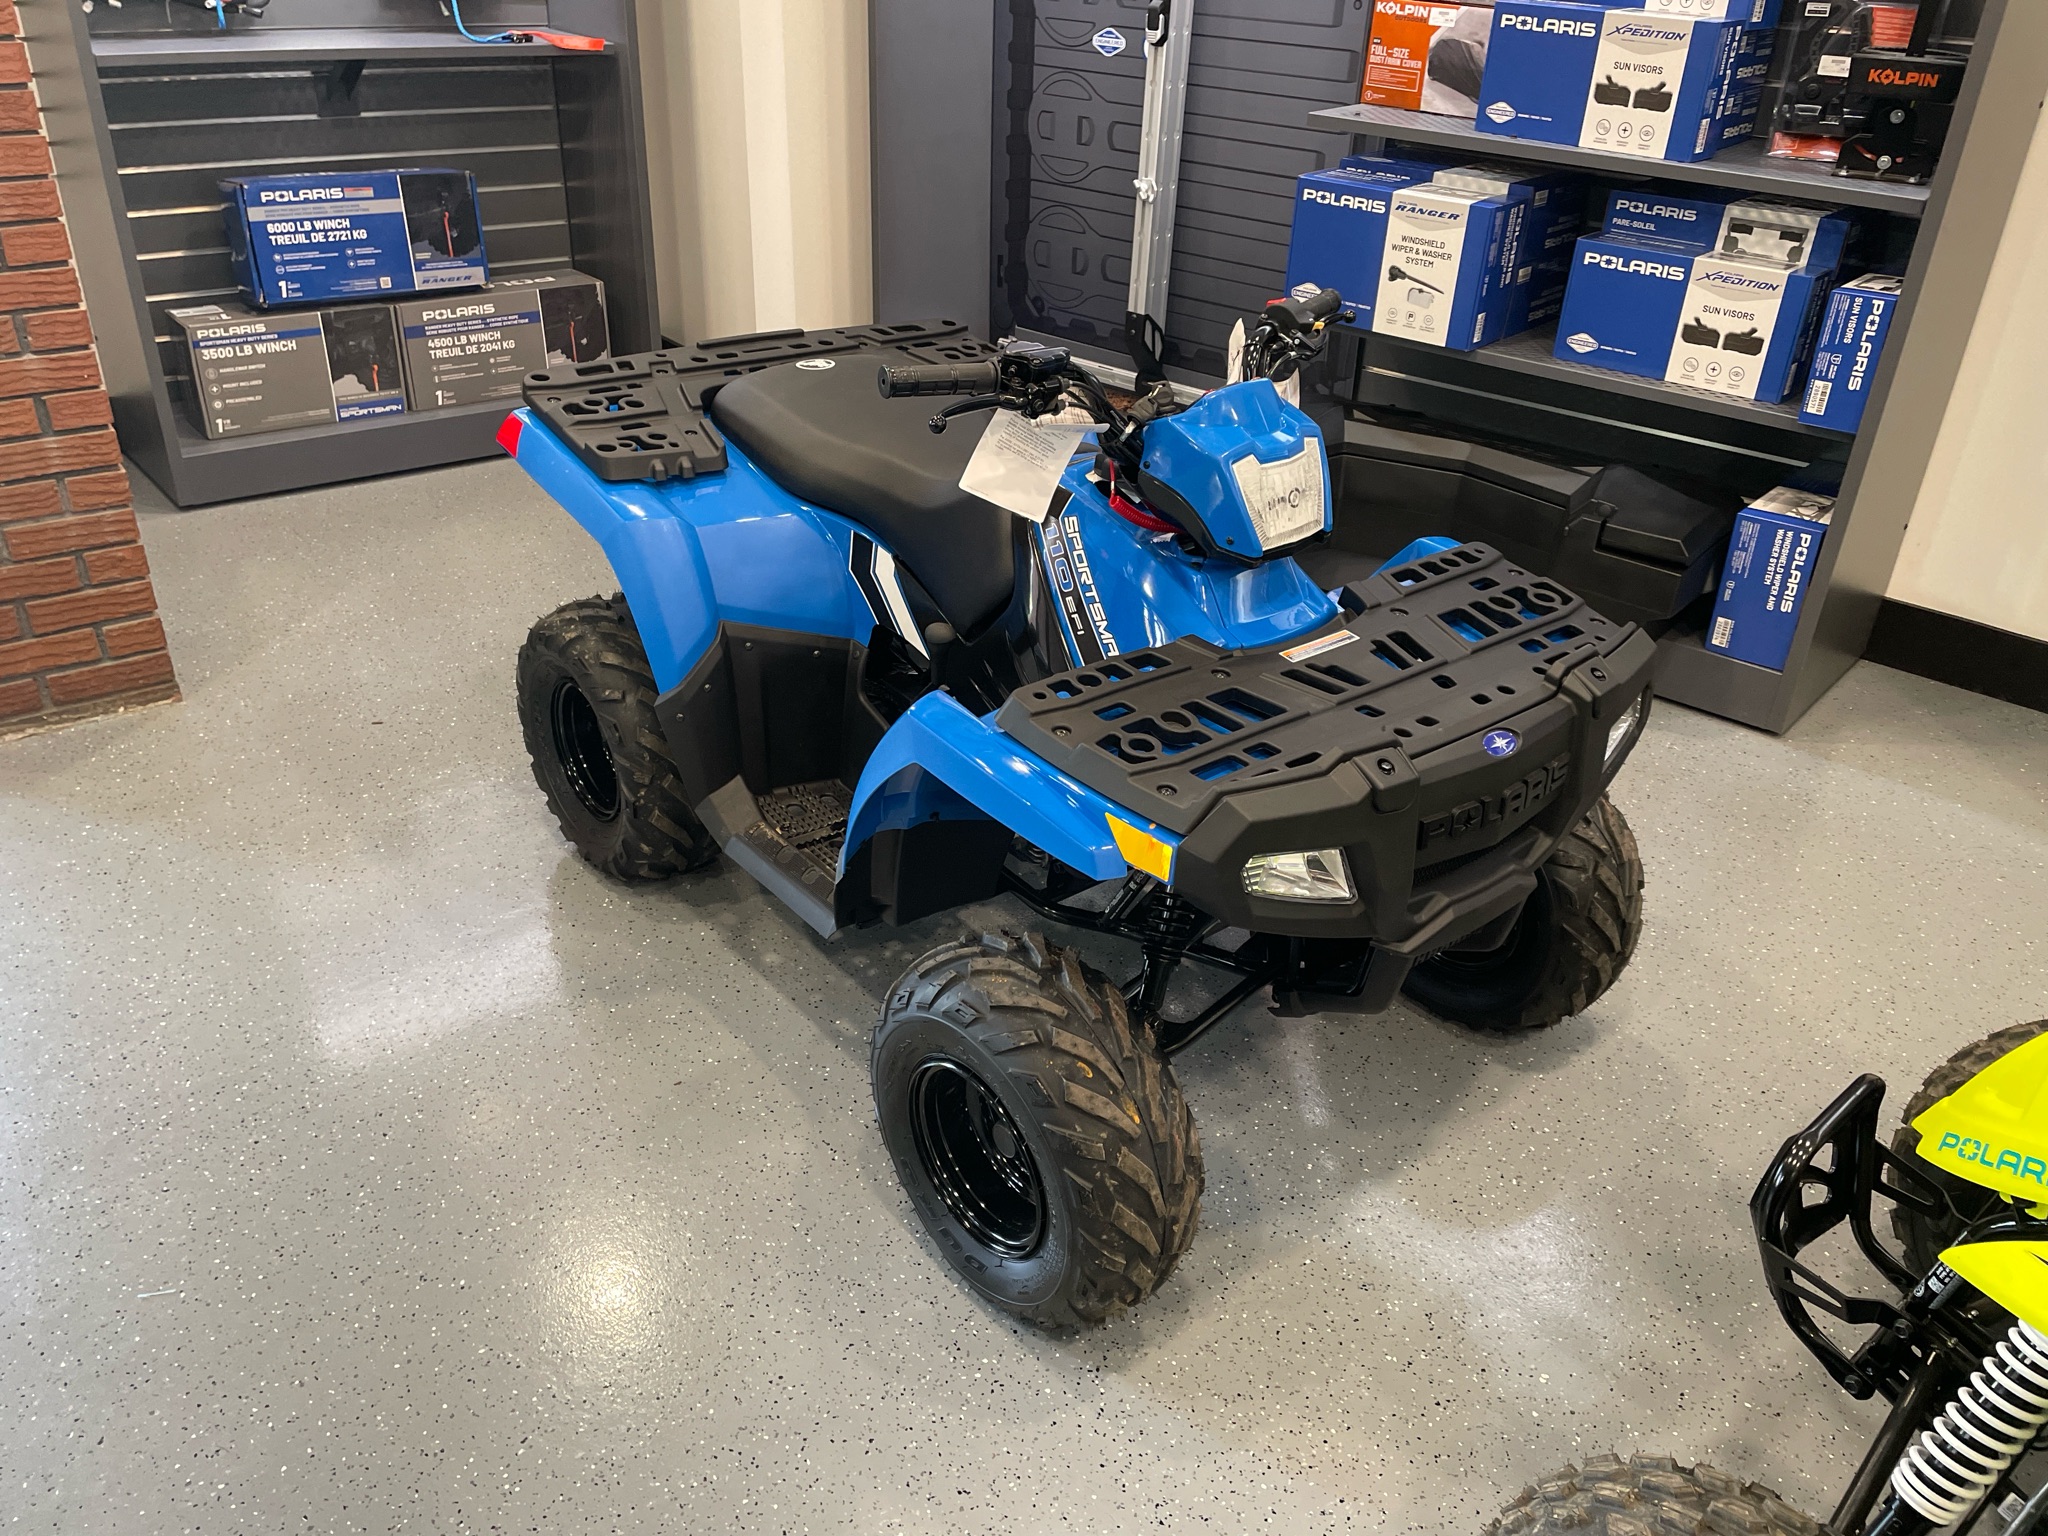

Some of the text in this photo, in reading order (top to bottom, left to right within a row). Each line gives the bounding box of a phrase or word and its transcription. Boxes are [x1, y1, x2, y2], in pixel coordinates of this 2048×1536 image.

[1376, 1, 1430, 18] KOLPIN
[1500, 13, 1597, 38] POLARIS
[1606, 23, 1687, 41] XPEDITION
[1371, 45, 1410, 59] FULL-SIZE
[1402, 59, 1422, 69] COVER
[1613, 61, 1664, 75] SUN VISORS
[1716, 25, 1742, 120] POLARIS
[1867, 68, 1939, 88] KOLPIN
[260, 187, 344, 203] POLARIS
[1302, 188, 1386, 214] POLARIS
[1394, 205, 1460, 221] RANGER
[1616, 199, 1697, 222] POLARIS
[266, 218, 351, 234] 6000 LB WINCH
[1612, 217, 1656, 231] PARE-SOLEIL
[269, 229, 368, 246] TREUIL DE 2721 KG
[1401, 234, 1446, 250] WINDSHIELD
[1505, 204, 1525, 284] POLARIS
[1391, 244, 1452, 262] WIPER & WASHER
[1405, 256, 1435, 268] SYSTEM
[1583, 252, 1686, 282] POLARIS
[422, 275, 472, 284] RANGER
[1696, 270, 1780, 292] XPEDITION
[278, 280, 288, 299] 1
[422, 304, 496, 322] POLARIS
[1702, 304, 1756, 322] SUN VISORS
[1844, 296, 1864, 344] SUN VISORS
[196, 323, 266, 339] POLARIS
[428, 331, 500, 348] 4500 LB WINCH
[201, 340, 297, 360] 3500 LB WINCH
[429, 340, 516, 360] TREUIL DE 2041 KG
[1848, 299, 1885, 391] POLARIS
[435, 390, 442, 406] 1
[340, 404, 402, 418] SPORTSMAN
[216, 418, 223, 434] 1
[1764, 529, 1785, 585] WASHER SYSTEM
[1046, 522, 1085, 635] 110 EFI
[1766, 531, 1794, 611] WINDSHIELD WIPER AND
[1780, 532, 1812, 613] POLARIS
[1064, 516, 1120, 657] SPORTSMA
[1418, 751, 1571, 851] POLARIS
[1938, 1132, 2048, 1186] POLAR
